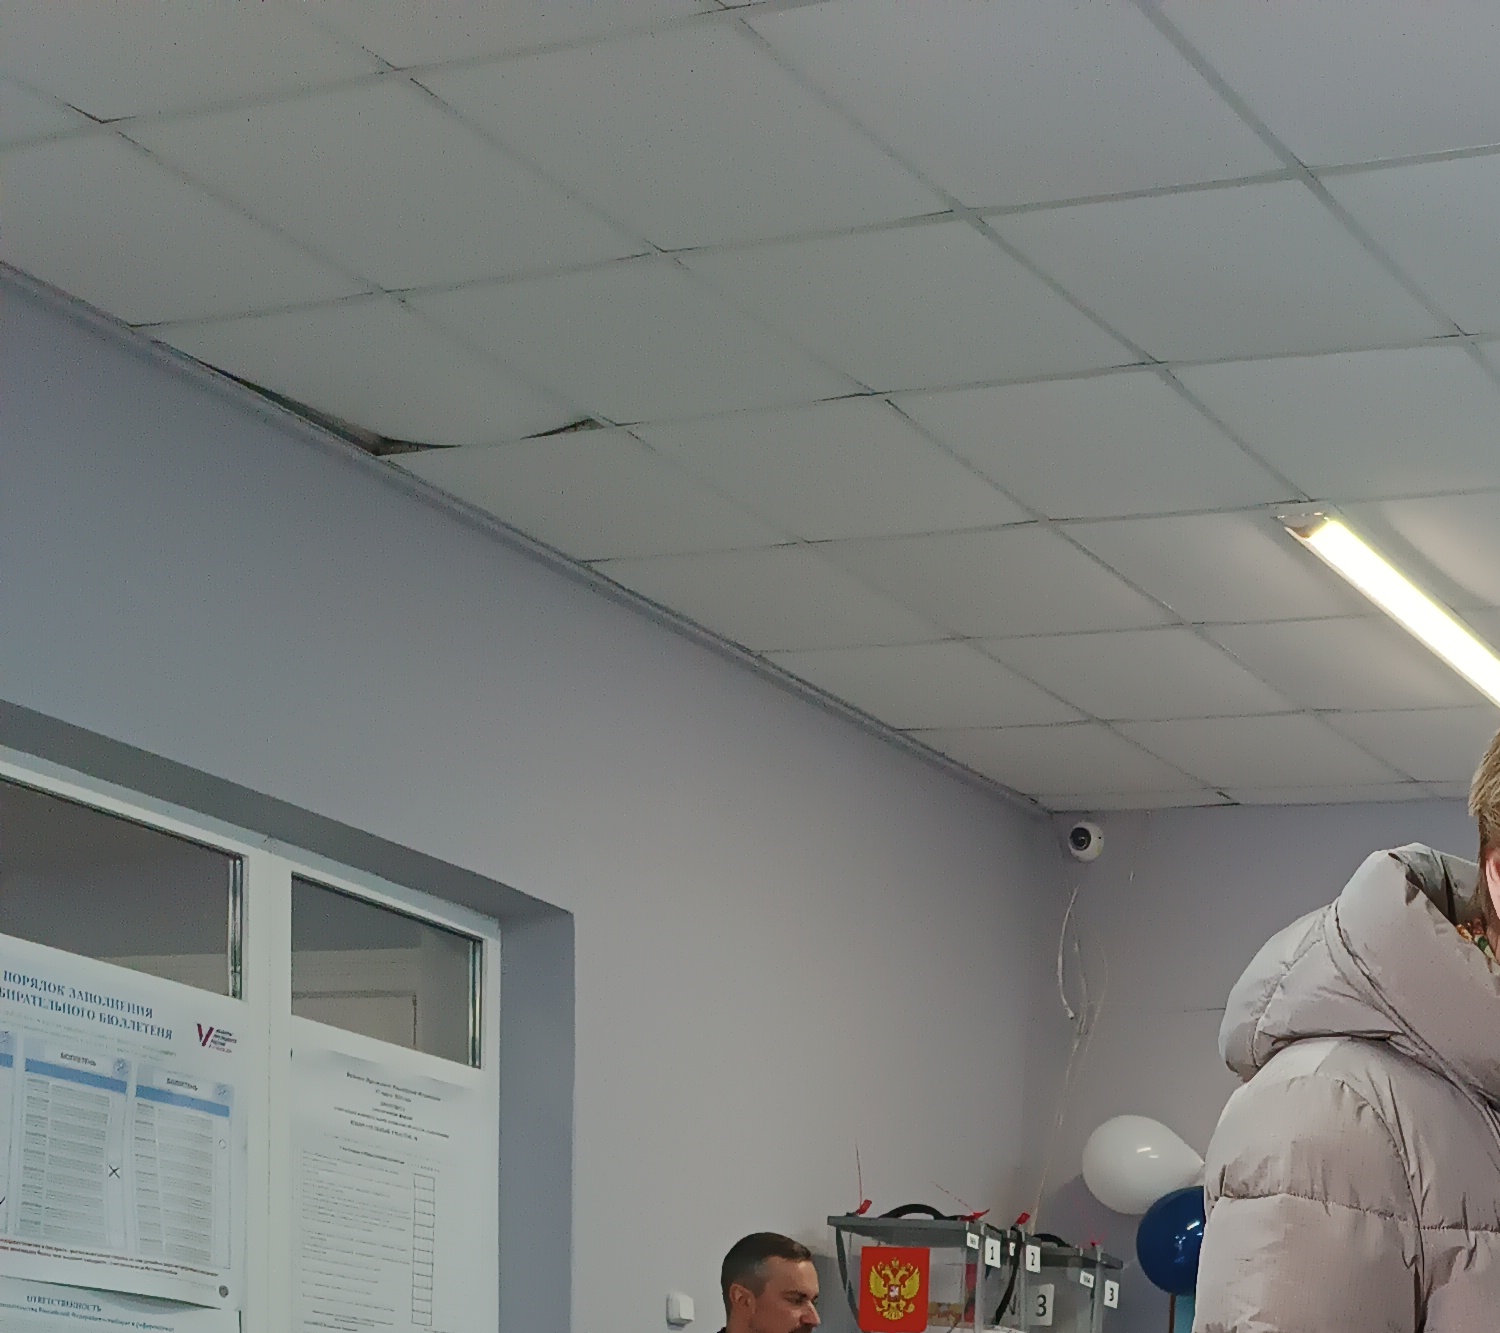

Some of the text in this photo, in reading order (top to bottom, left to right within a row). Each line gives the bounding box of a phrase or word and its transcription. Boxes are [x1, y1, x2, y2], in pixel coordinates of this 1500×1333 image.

[3, 970, 153, 1019] ПОРЯДОК ЗАПОЛНЕНИЯ
[99, 1012, 173, 1041] БЮЛЛЕТЕНЯ
[1030, 1252, 1035, 1266] 2
[1035, 1294, 1047, 1317] 3
[1109, 1287, 1115, 1302] 3
